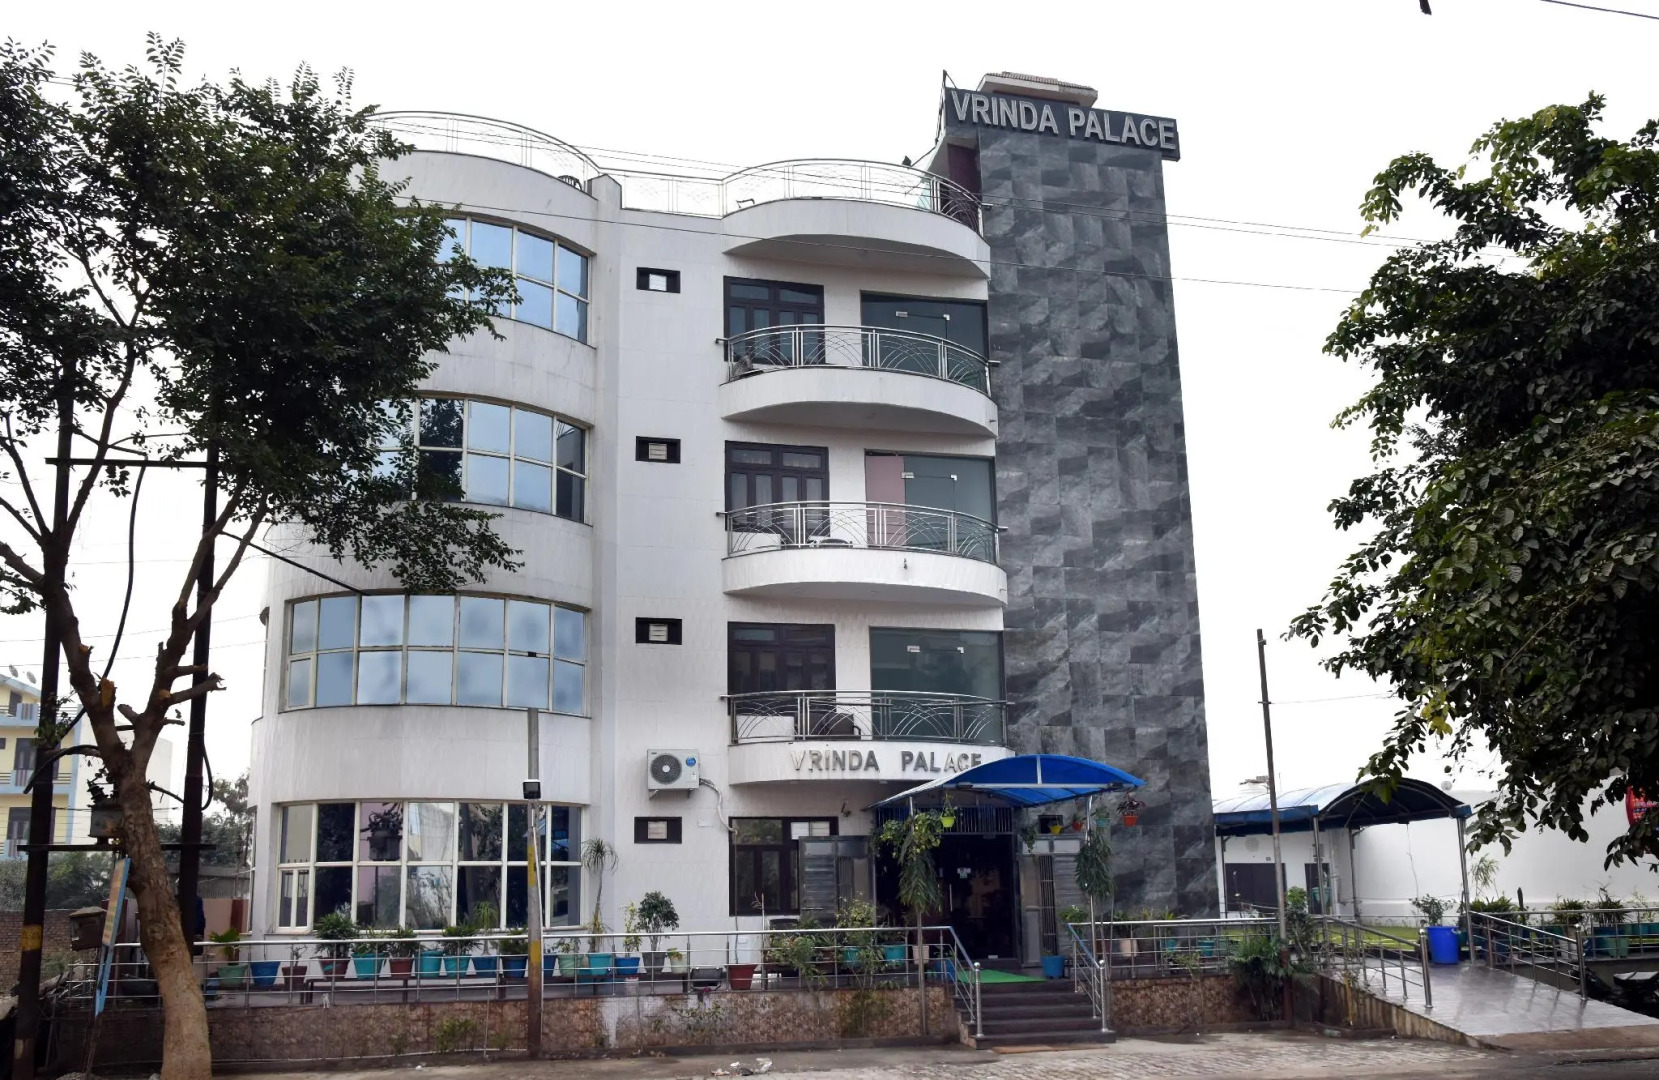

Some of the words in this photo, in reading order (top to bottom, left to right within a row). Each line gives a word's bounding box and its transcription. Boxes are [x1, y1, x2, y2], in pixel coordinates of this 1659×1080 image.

[951, 90, 1060, 136] VRINDA
[1067, 107, 1177, 150] PALACE
[791, 750, 880, 772] VRINDA
[901, 750, 982, 773] PALACE
